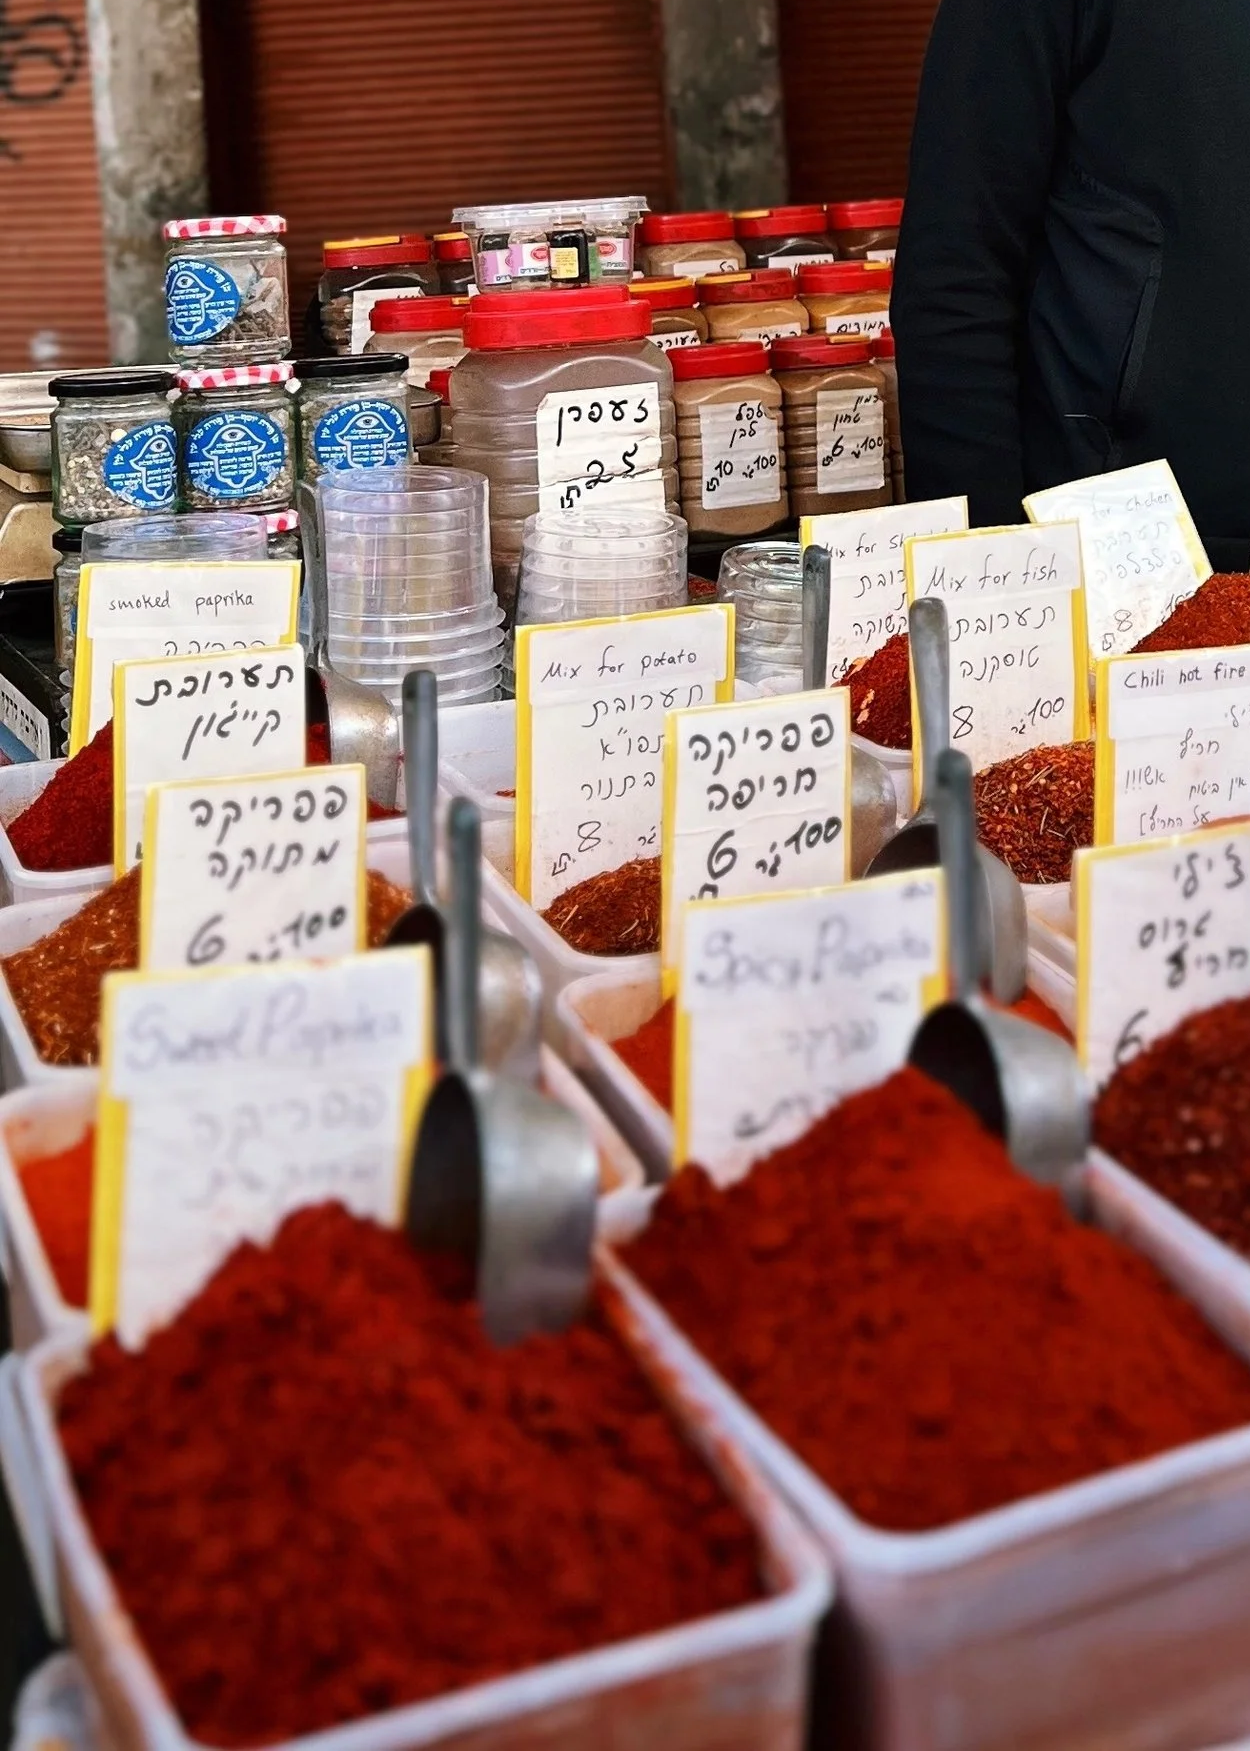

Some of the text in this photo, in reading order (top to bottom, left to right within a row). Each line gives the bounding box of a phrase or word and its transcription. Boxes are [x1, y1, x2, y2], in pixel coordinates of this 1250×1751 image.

[833, 413, 861, 431] טחון
[853, 395, 880, 412] כמון
[556, 399, 650, 447] זעפרן
[729, 421, 759, 449] לבן
[831, 435, 884, 457] 100 6
[714, 455, 777, 478] 100 10
[856, 532, 877, 557] for
[925, 548, 1059, 596] Mix for fish
[108, 590, 254, 615] smoked paprika
[1113, 609, 1133, 632] 8
[852, 614, 908, 645] קשוקה
[950, 606, 1056, 642] תערובת
[541, 645, 698, 682] Mix for potato
[959, 644, 1040, 684] טוסקנה
[1124, 662, 1246, 689] Chili hot fire
[135, 663, 295, 707] תערובת
[582, 684, 704, 728] תערובת
[952, 696, 1065, 739] 100 8
[688, 712, 835, 776] פפריקה
[1179, 727, 1220, 760] חריף
[581, 771, 656, 802] בתנור
[706, 767, 817, 813] חריפה
[188, 785, 348, 845] פפריקה
[577, 820, 602, 852] 8
[707, 815, 842, 881] 100 6
[207, 840, 340, 891] מתוקה
[185, 912, 226, 965] 6
[1165, 940, 1249, 990] חריף
[1113, 1008, 1150, 1067] 6
